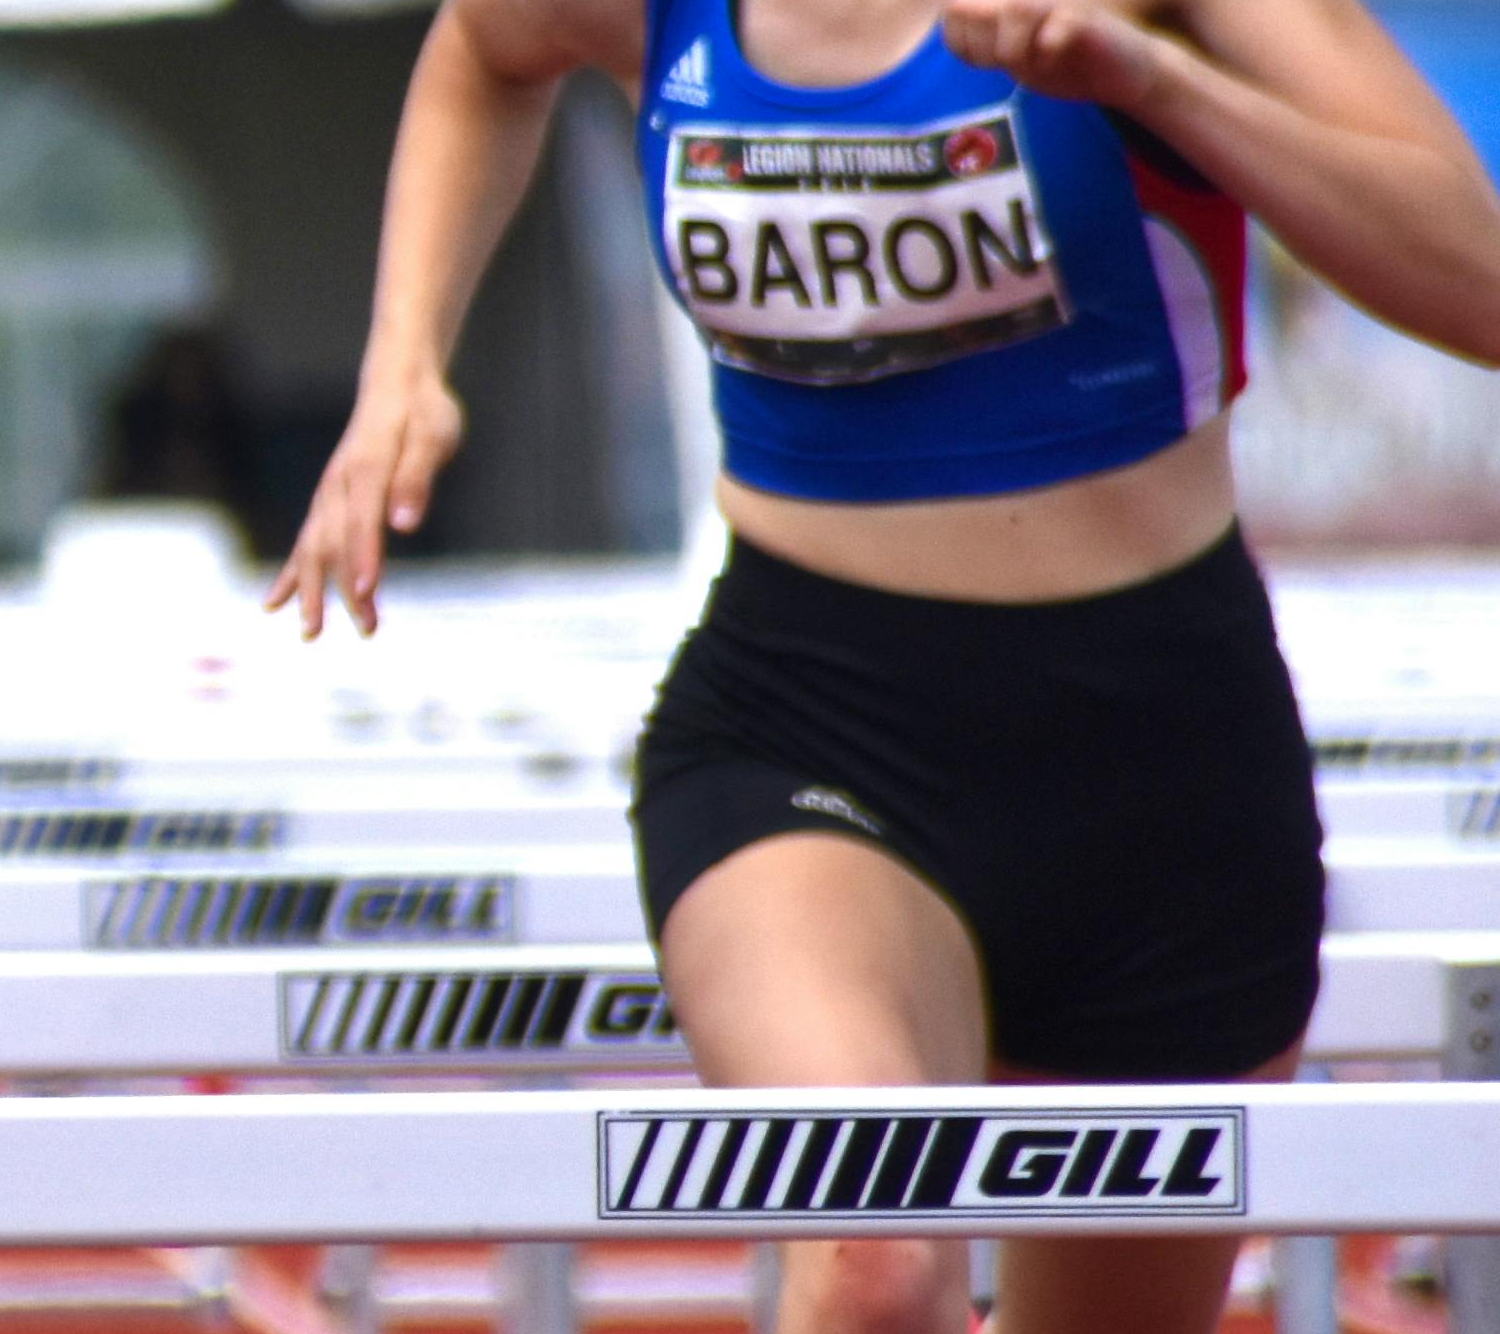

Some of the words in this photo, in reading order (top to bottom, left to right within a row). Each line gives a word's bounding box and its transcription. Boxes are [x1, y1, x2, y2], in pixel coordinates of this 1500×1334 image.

[743, 143, 811, 175] LEGION
[817, 141, 935, 175] NATIONALS
[678, 200, 1040, 308] BARON
[346, 889, 502, 933] GILL
[977, 1128, 1222, 1197] GILL
